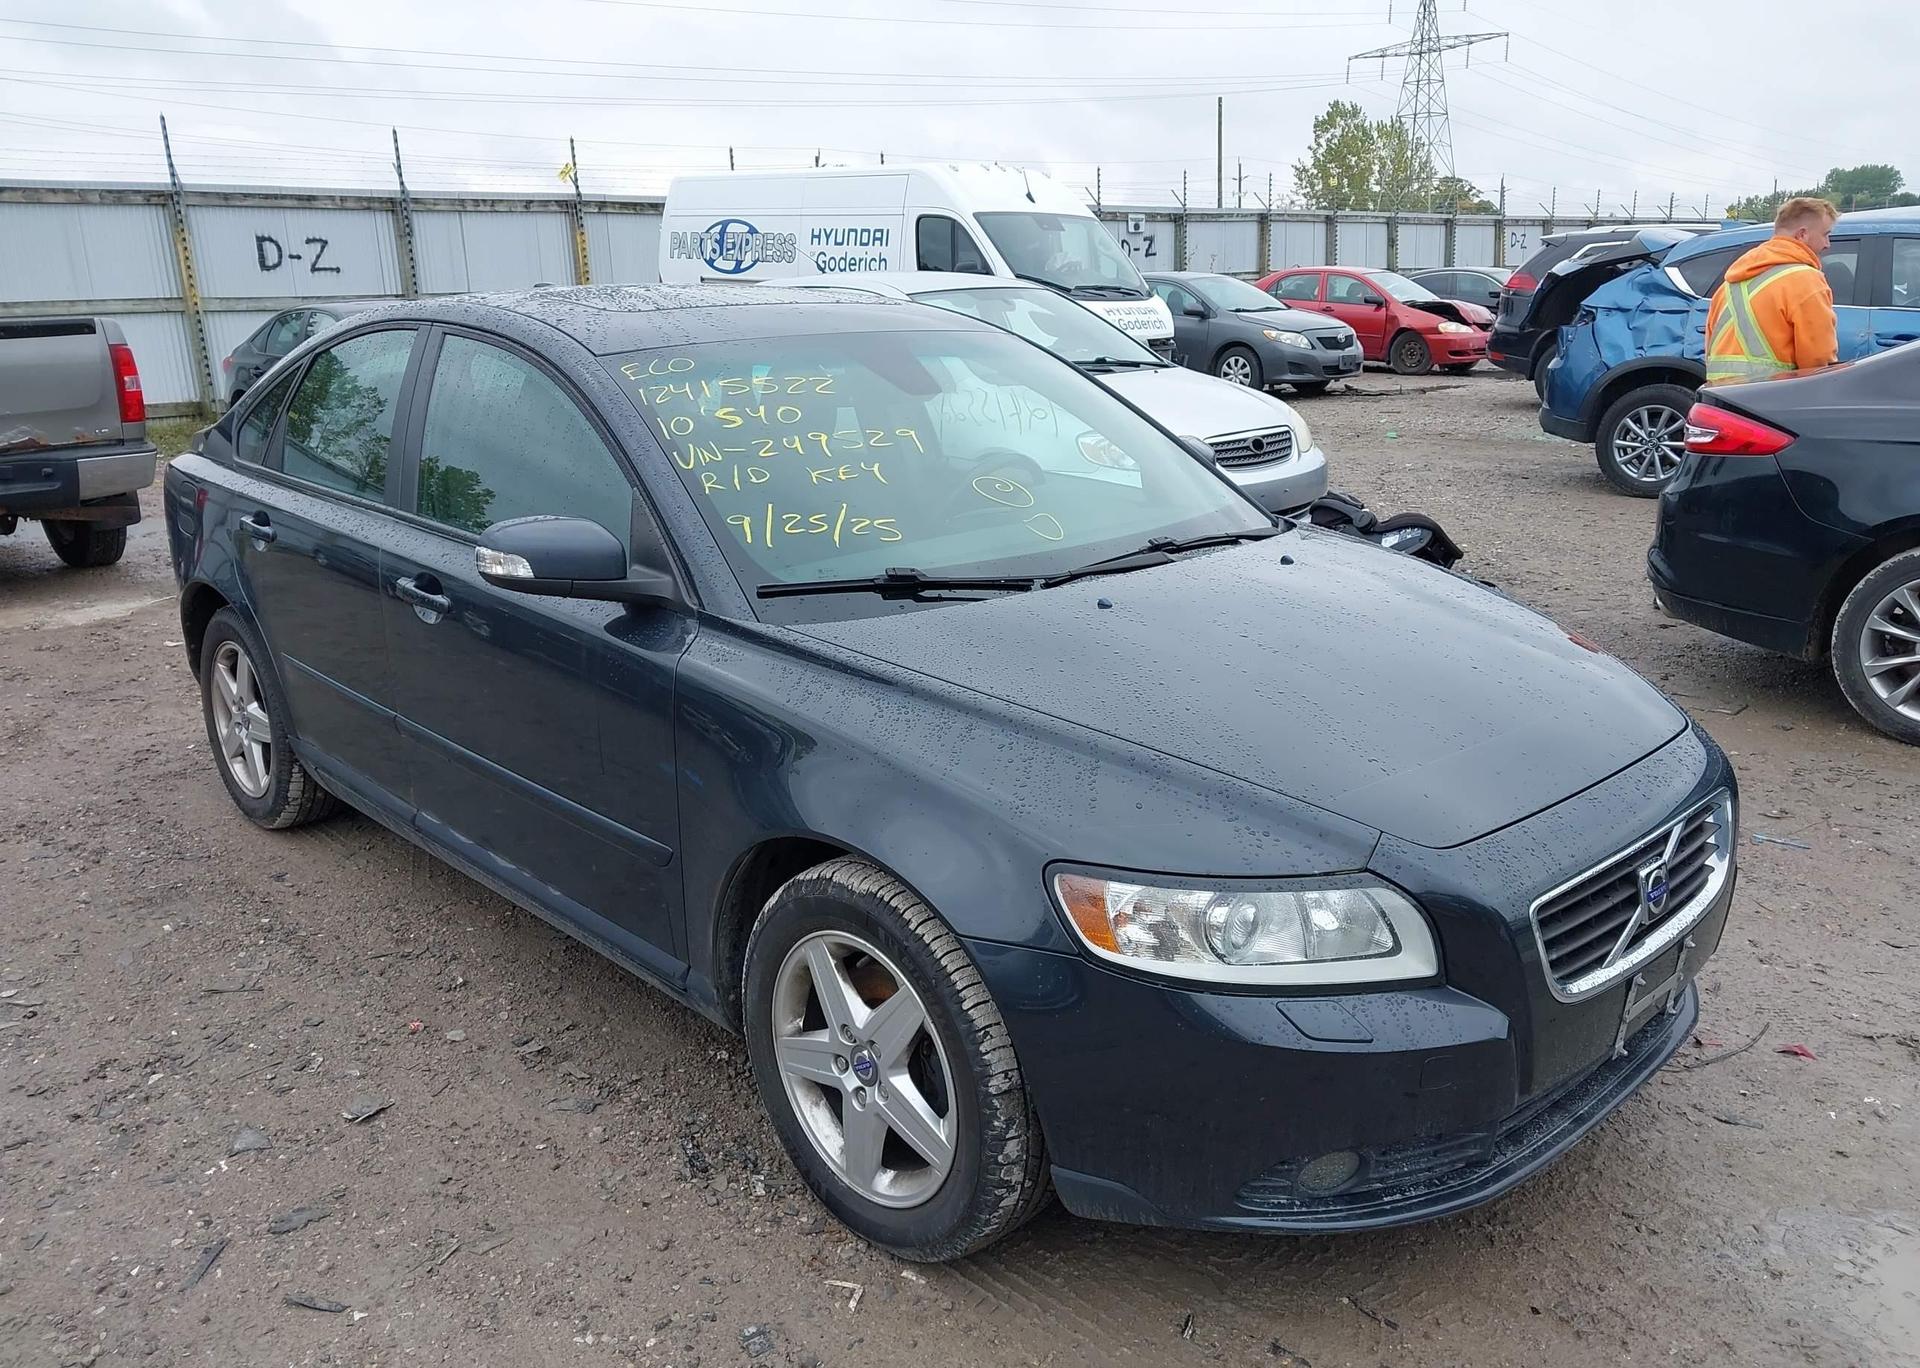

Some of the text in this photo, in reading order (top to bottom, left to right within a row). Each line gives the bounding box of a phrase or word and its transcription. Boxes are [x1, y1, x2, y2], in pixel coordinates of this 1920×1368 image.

[669, 231, 797, 263] PARTS EXPRESS
[810, 228, 890, 247] HYUNDAI
[255, 234, 341, 274] D-Z
[816, 250, 888, 272] Goderich
[1117, 316, 1167, 331] Goderich
[619, 357, 697, 381] ECO
[638, 374, 837, 405] 12415522
[656, 416, 695, 440] 10
[806, 461, 889, 485] KEY
[727, 502, 903, 548] 9/25/25
